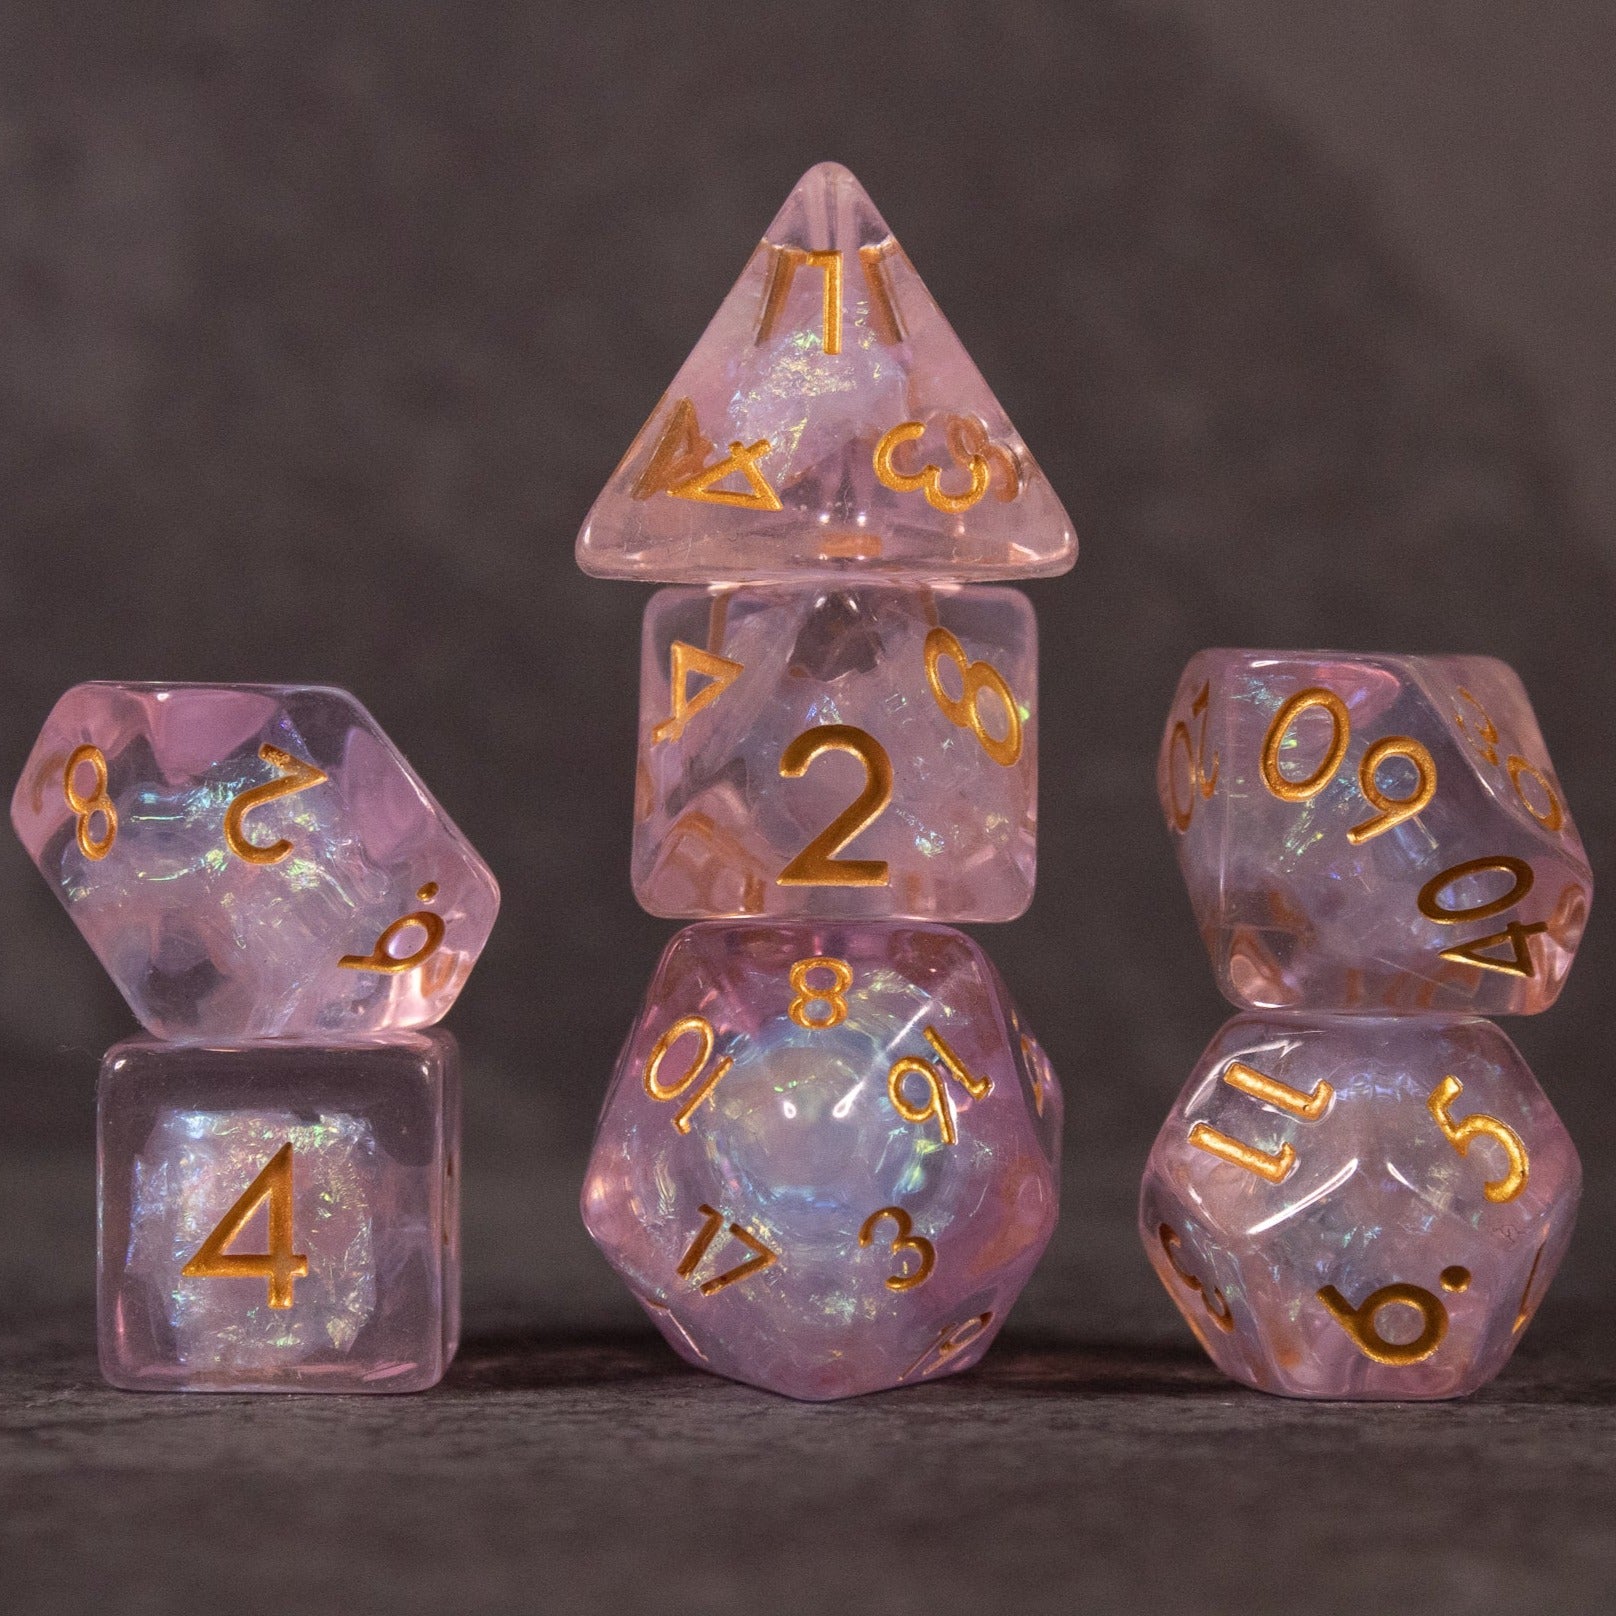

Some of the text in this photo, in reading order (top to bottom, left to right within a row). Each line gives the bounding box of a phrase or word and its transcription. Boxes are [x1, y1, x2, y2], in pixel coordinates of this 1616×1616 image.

[807, 250, 843, 356] 1
[666, 438, 784, 513] 4
[873, 421, 990, 514] 3
[651, 640, 745, 746] 4
[924, 626, 1024, 767] 8
[64, 744, 118, 860] 8
[224, 743, 328, 865] 2
[776, 724, 893, 886] 2
[788, 956, 853, 1029] 8
[643, 1015, 734, 1135] 10
[1427, 1075, 1529, 1203] 5
[181, 1142, 308, 1310] 4
[858, 1206, 936, 1291] 3
